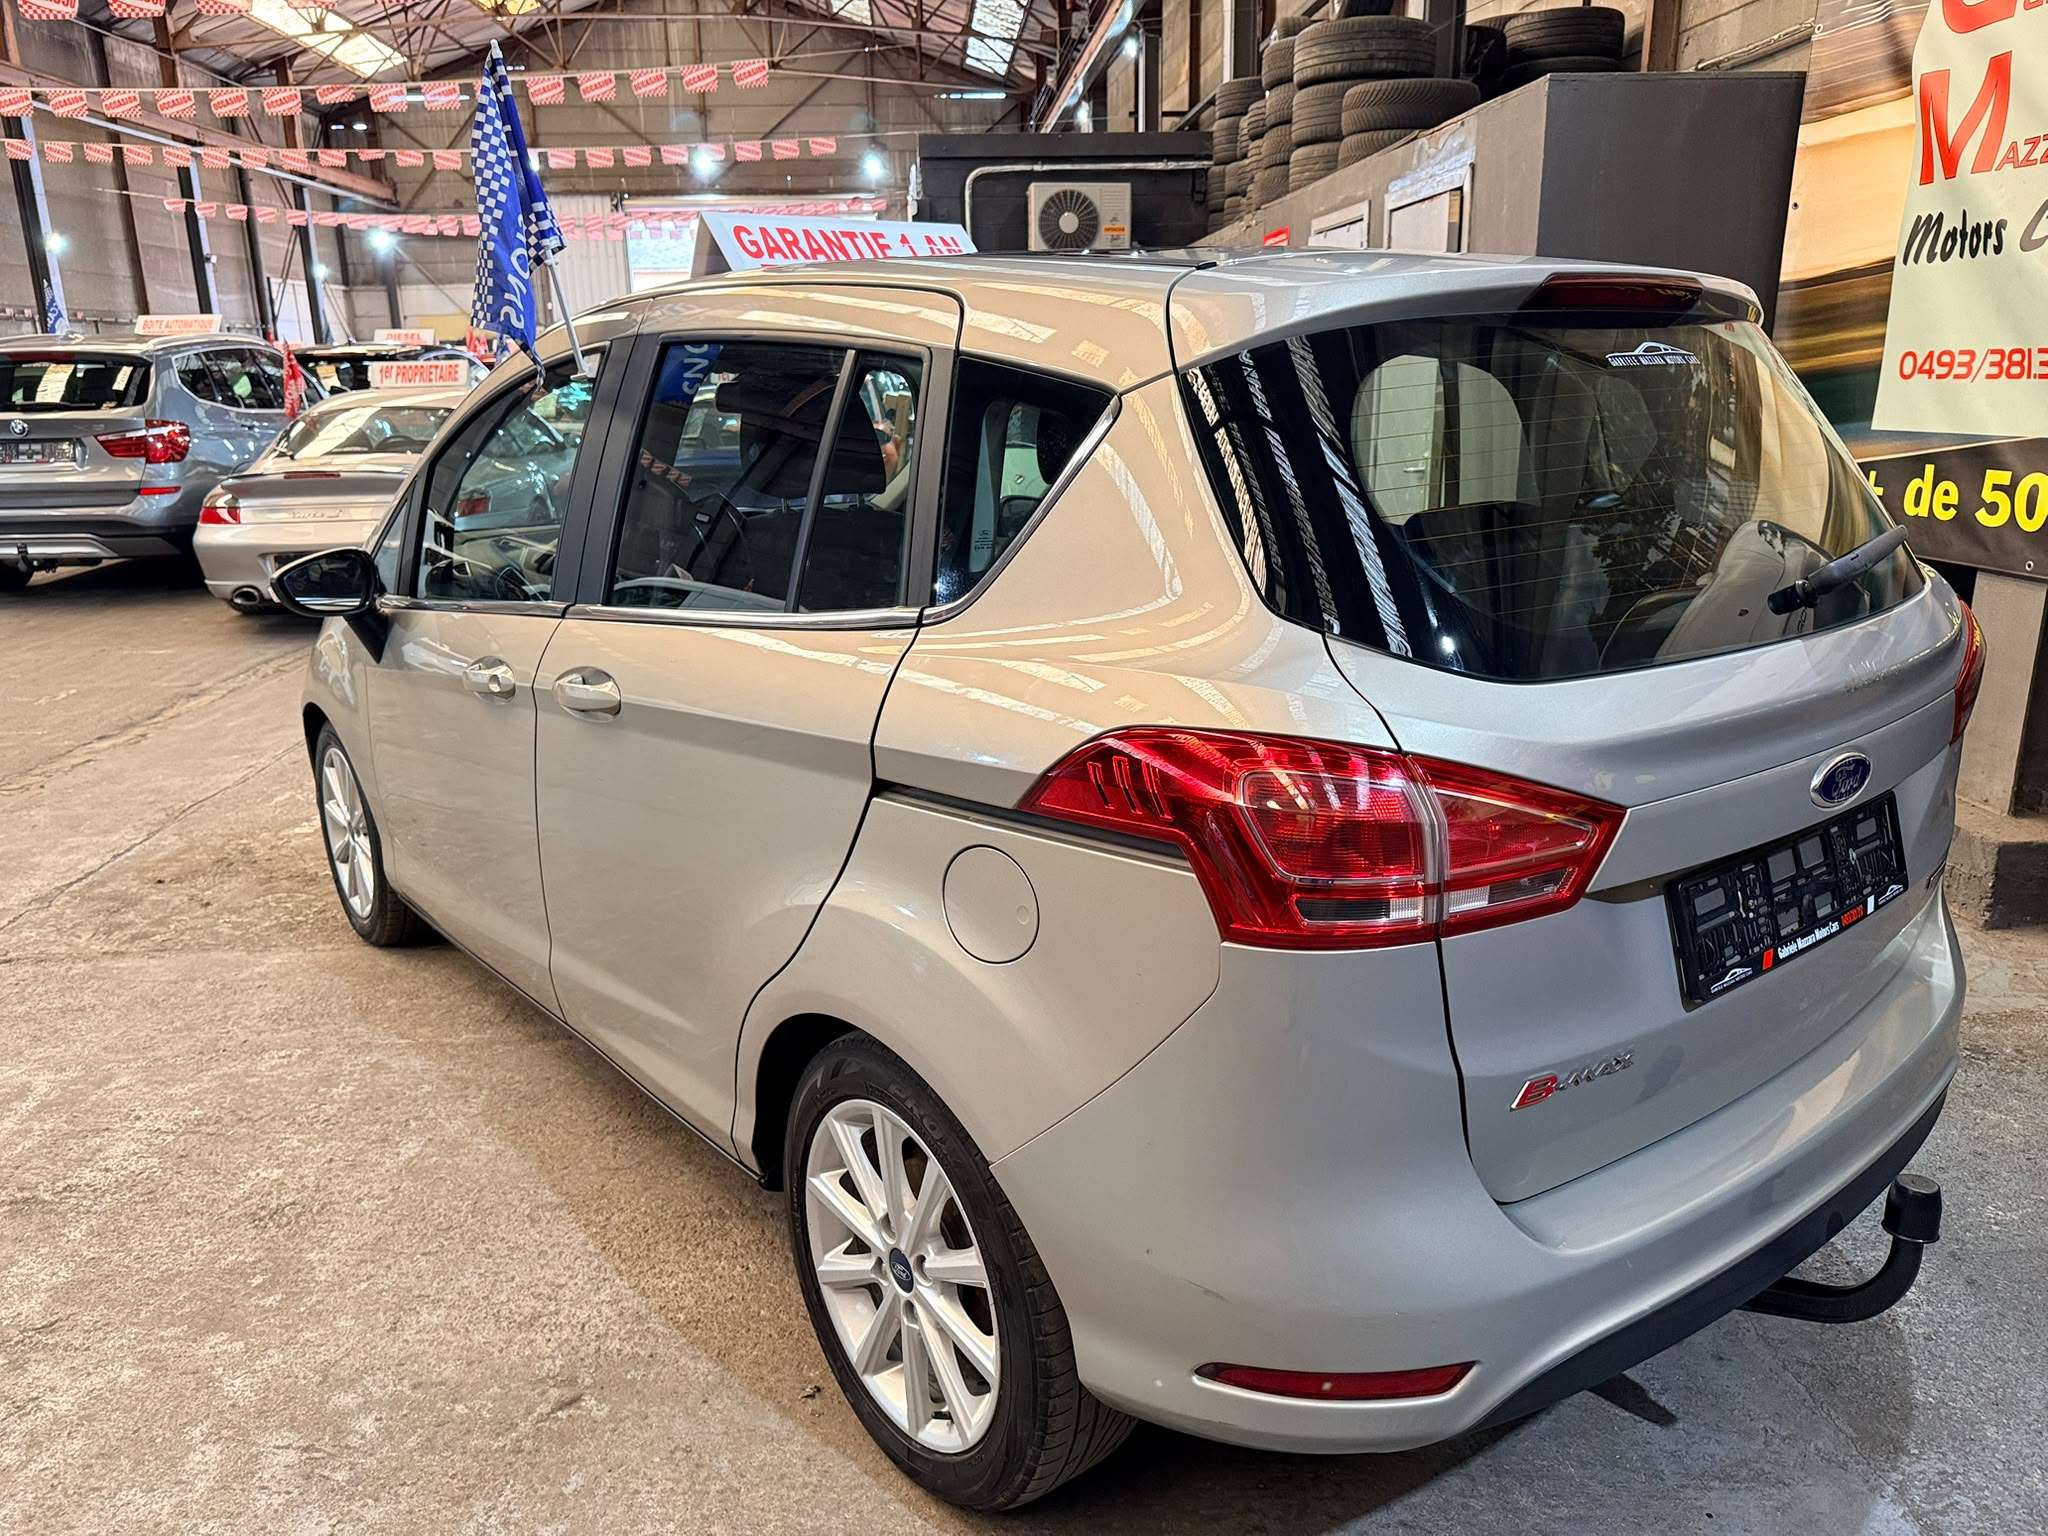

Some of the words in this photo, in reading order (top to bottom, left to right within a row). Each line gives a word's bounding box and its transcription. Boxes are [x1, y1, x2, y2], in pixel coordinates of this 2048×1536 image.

[634, 74, 665, 90] OCCASION
[685, 69, 717, 88] OCCASION
[735, 63, 767, 83] OCCASION
[530, 81, 562, 98] OCCASION
[582, 78, 613, 95] OCCASION
[51, 94, 84, 111] OCCASION
[104, 94, 138, 111] OCCASION
[159, 94, 193, 111] OCCASION
[213, 94, 246, 111] OCCASION
[266, 93, 299, 110] OCCASION
[732, 225, 892, 262] GARANTIE
[1902, 208, 2008, 266] Motors
[379, 365, 393, 384] 1er
[395, 364, 461, 385] PROPRIETAIRE
[1903, 463, 1960, 521] de
[1831, 762, 1862, 798] Ford
[1777, 940, 1798, 960] Gabriele
[1796, 932, 1816, 951] Mazzara
[1814, 924, 1831, 942] Motors
[1829, 920, 1840, 934] Cars
[1510, 1052, 1634, 1112] B-MAX
